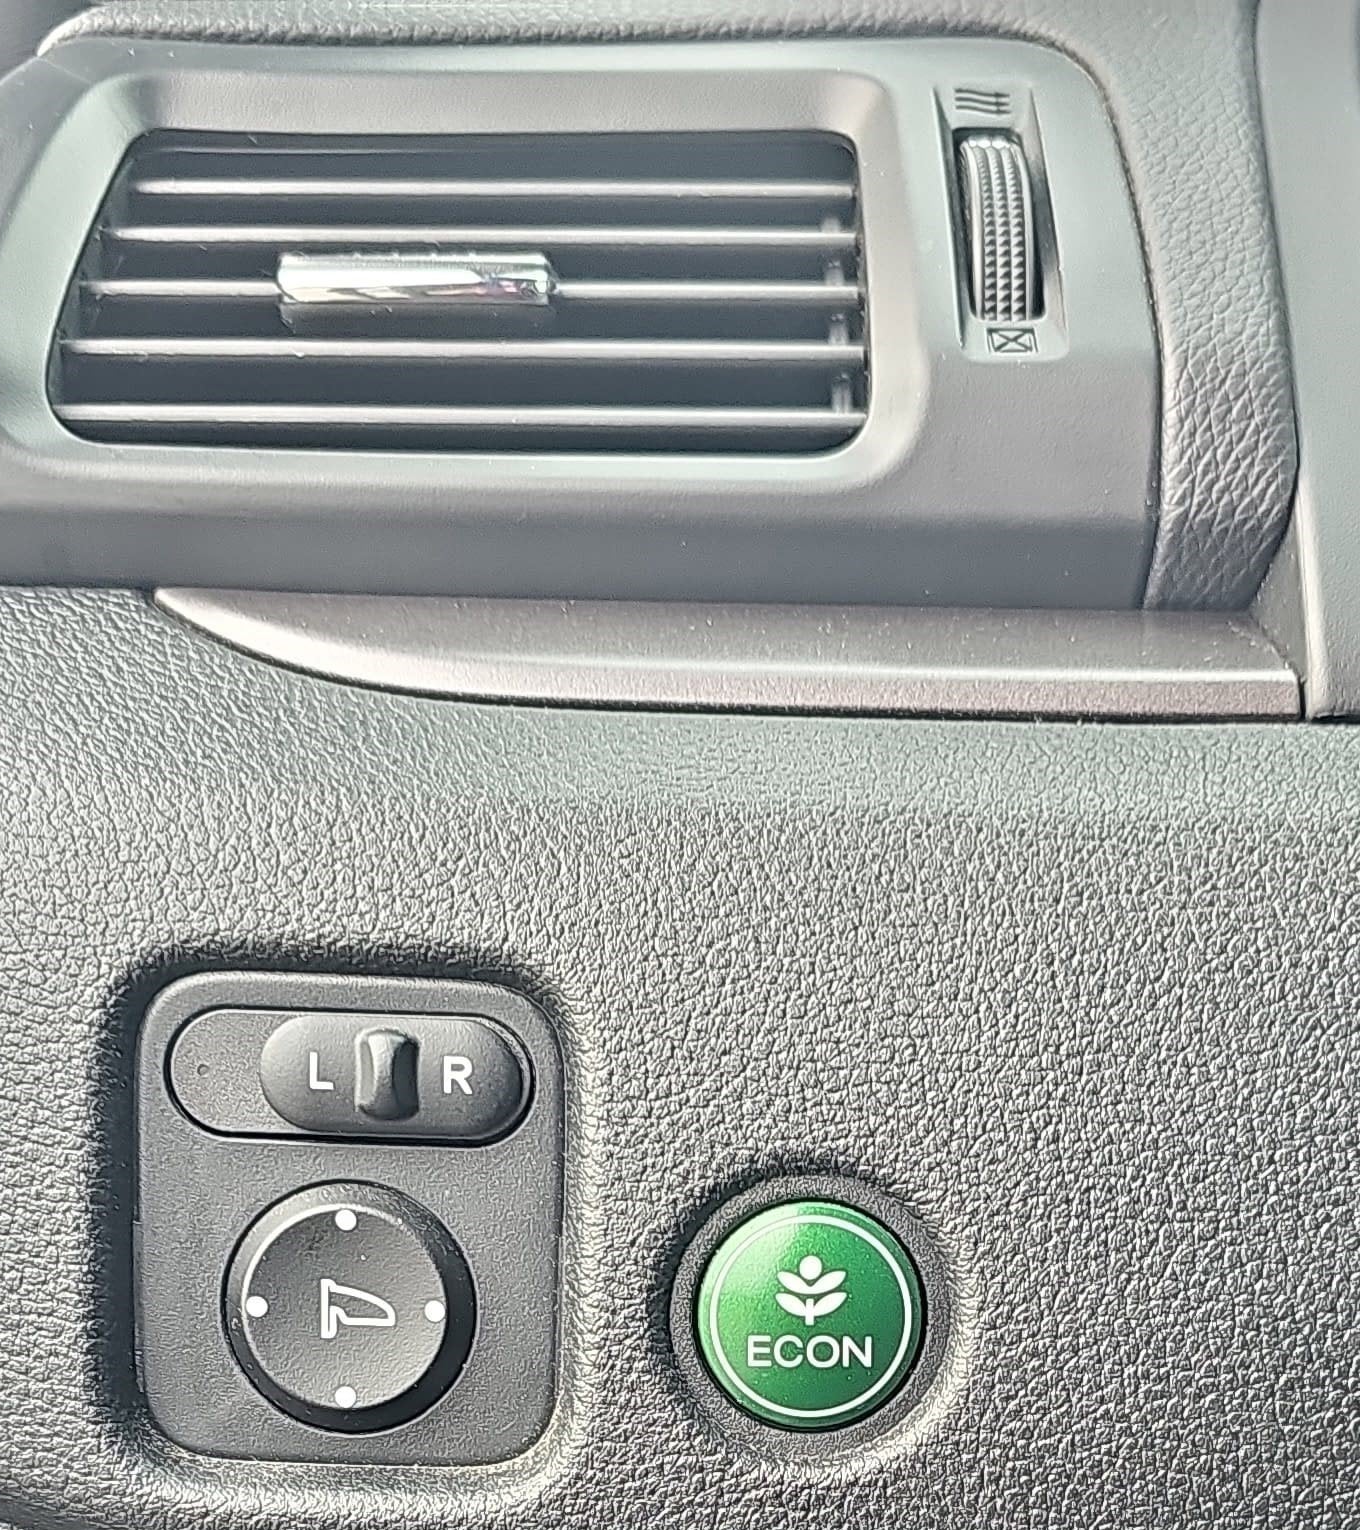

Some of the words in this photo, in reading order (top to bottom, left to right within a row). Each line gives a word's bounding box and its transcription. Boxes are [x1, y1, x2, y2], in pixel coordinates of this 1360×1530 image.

[307, 1052, 335, 1093] L
[441, 1055, 474, 1096] R
[745, 1333, 874, 1371] ECON
